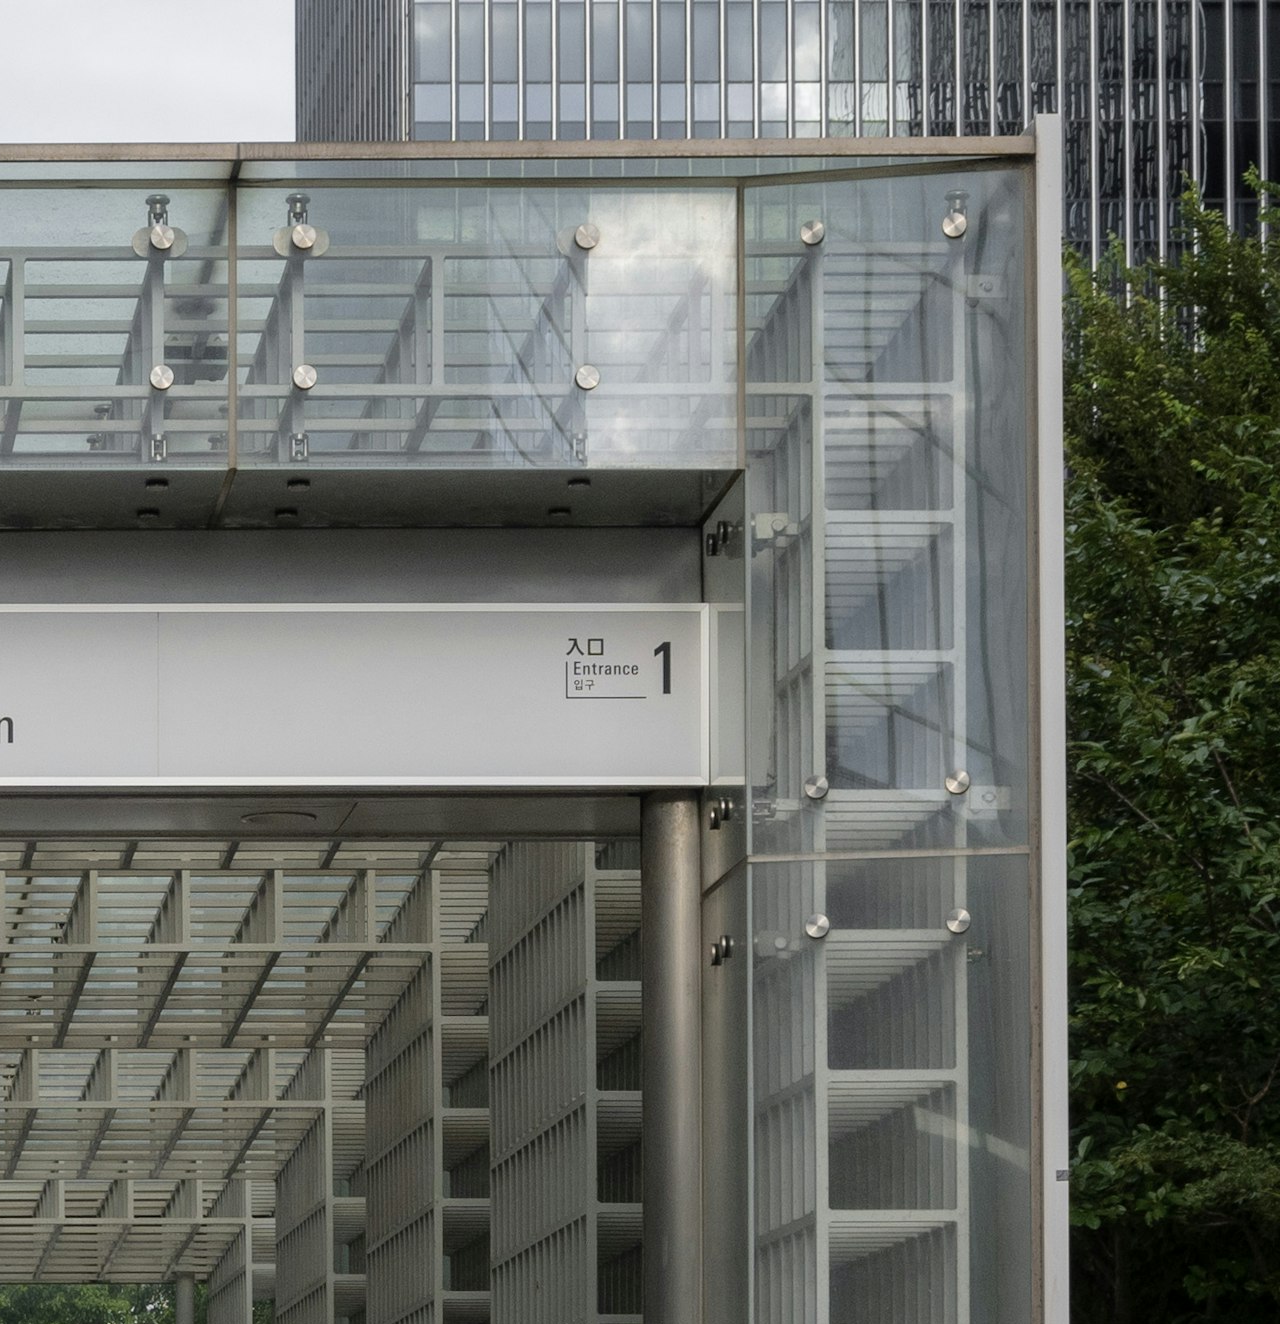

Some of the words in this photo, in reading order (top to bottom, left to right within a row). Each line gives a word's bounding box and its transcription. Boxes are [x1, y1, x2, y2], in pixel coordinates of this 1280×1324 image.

[566, 637, 604, 656] 入口
[573, 661, 639, 676] Entrance
[653, 641, 672, 695] 1
[573, 679, 596, 691] 입구
